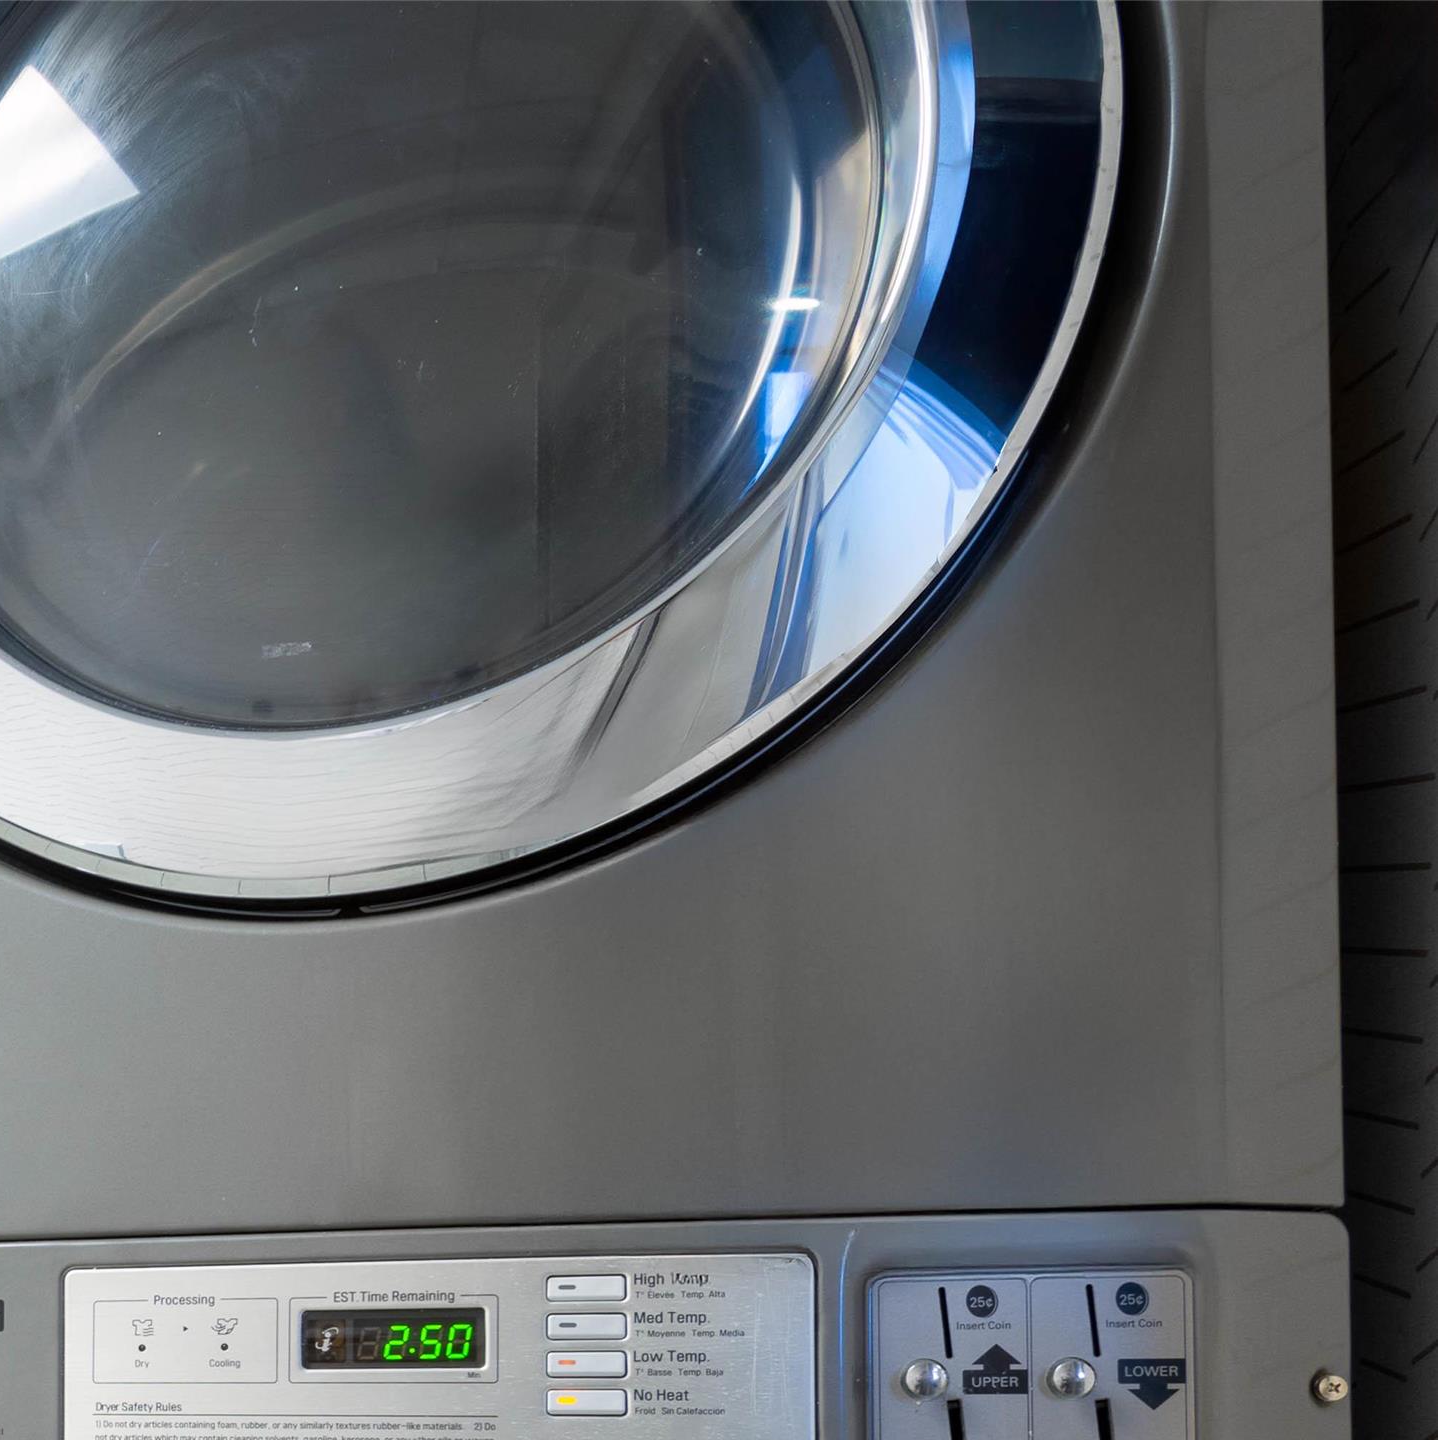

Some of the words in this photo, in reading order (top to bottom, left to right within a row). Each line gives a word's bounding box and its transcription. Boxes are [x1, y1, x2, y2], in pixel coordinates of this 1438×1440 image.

[634, 1273, 665, 1287] High
[153, 1294, 215, 1307] Processing
[392, 1290, 456, 1303] Remaining
[634, 1312, 663, 1324] Med
[668, 1311, 711, 1326] Temp.
[1105, 1318, 1135, 1329] Insert
[1137, 1317, 1163, 1329] Coin
[956, 1320, 985, 1331] Insert
[987, 1320, 1012, 1331] Coin
[383, 1324, 473, 1360] 2.50
[134, 1359, 149, 1368] Dry
[209, 1358, 241, 1368] Cooling
[633, 1351, 663, 1362] Low
[668, 1350, 711, 1365] Temp.
[1124, 1365, 1179, 1377] LOWER
[971, 1376, 1019, 1388] UPPER
[634, 1389, 653, 1401] No
[656, 1389, 689, 1401] Heat
[95, 1402, 119, 1413] Dryer
[121, 1402, 153, 1413] Safety
[155, 1402, 182, 1412] Rules
[128, 1421, 142, 1430] dry
[143, 1421, 173, 1429] articles
[174, 1421, 215, 1430] containing
[299, 1422, 333, 1431] similarly
[336, 1422, 370, 1430] textures
[474, 1423, 483, 1431] 2)
[484, 1423, 496, 1431] Do
